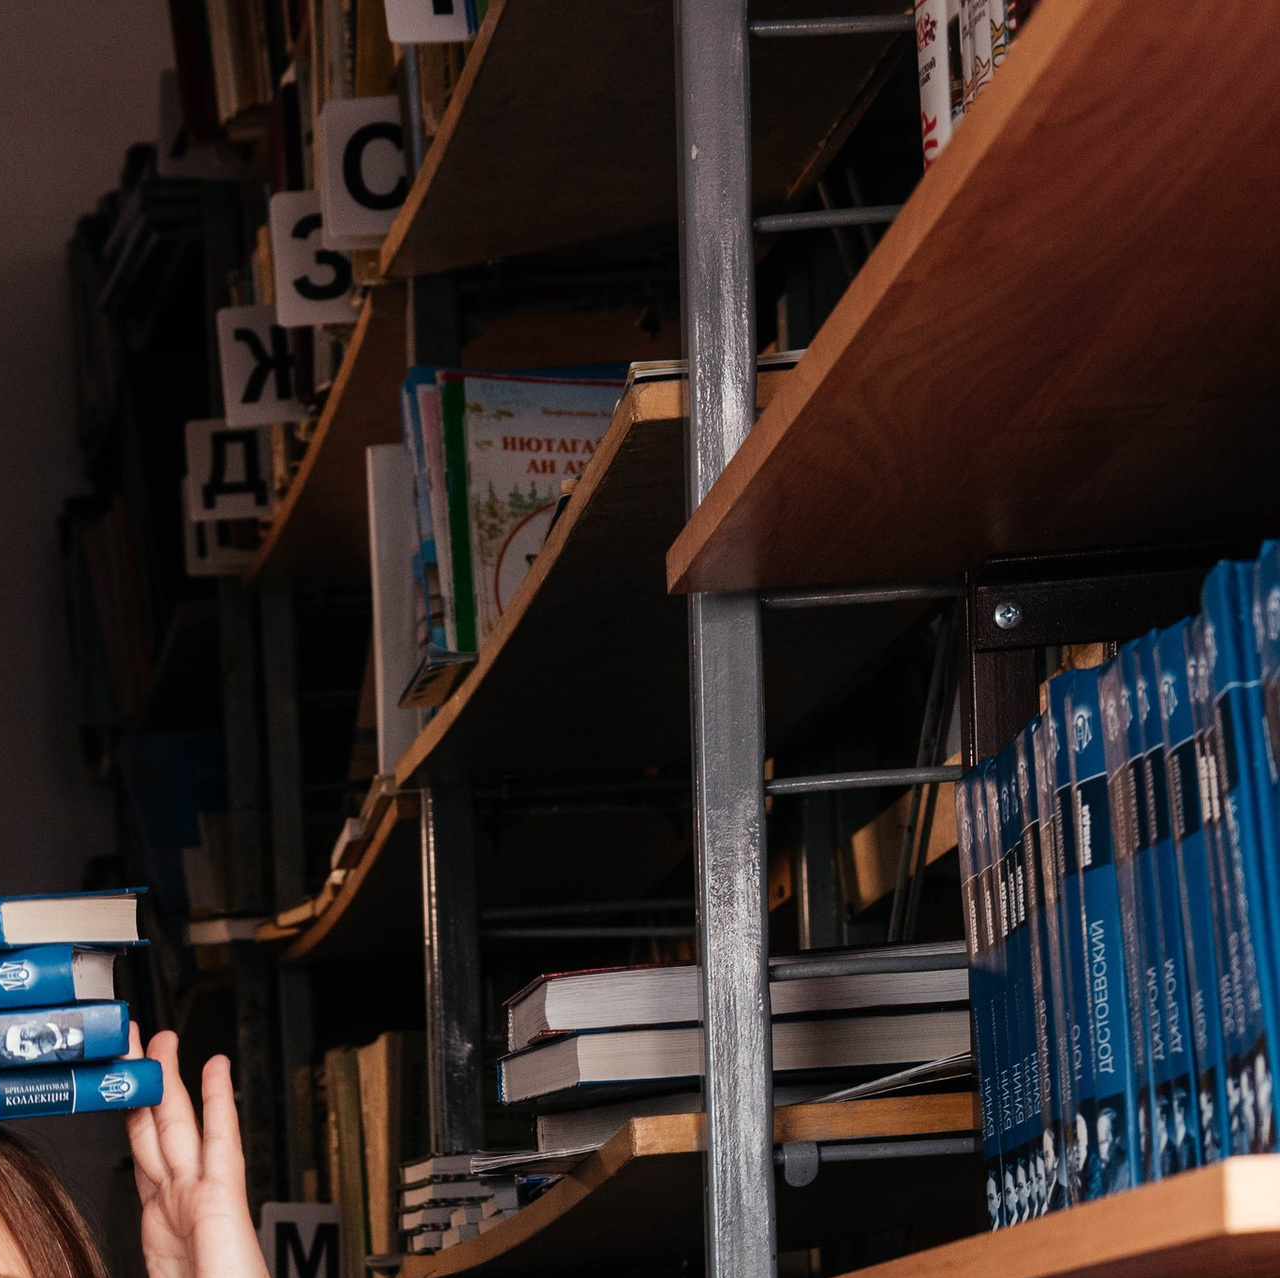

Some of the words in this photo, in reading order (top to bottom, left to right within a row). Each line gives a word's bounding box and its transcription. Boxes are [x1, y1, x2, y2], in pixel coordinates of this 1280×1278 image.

[343, 122, 410, 210] С
[203, 429, 268, 509] Д
[1088, 919, 1115, 1074] ДОСТОЕВСКИЙ
[1146, 966, 1165, 1060] ДЖЕРОМ
[1163, 958, 1184, 1054] ДЖЕРОМ
[5, 1081, 69, 1095] БРИЛЛИАНТОВАЯ
[1040, 1000, 1051, 1102] ГОНЧАРОВ
[5, 1091, 69, 1106] КОЛЛЕКЦИЯ
[984, 1077, 995, 1138] БУНИН
[1001, 1069, 1012, 1131] БУНИН
[1013, 1062, 1024, 1125] БУНИН
